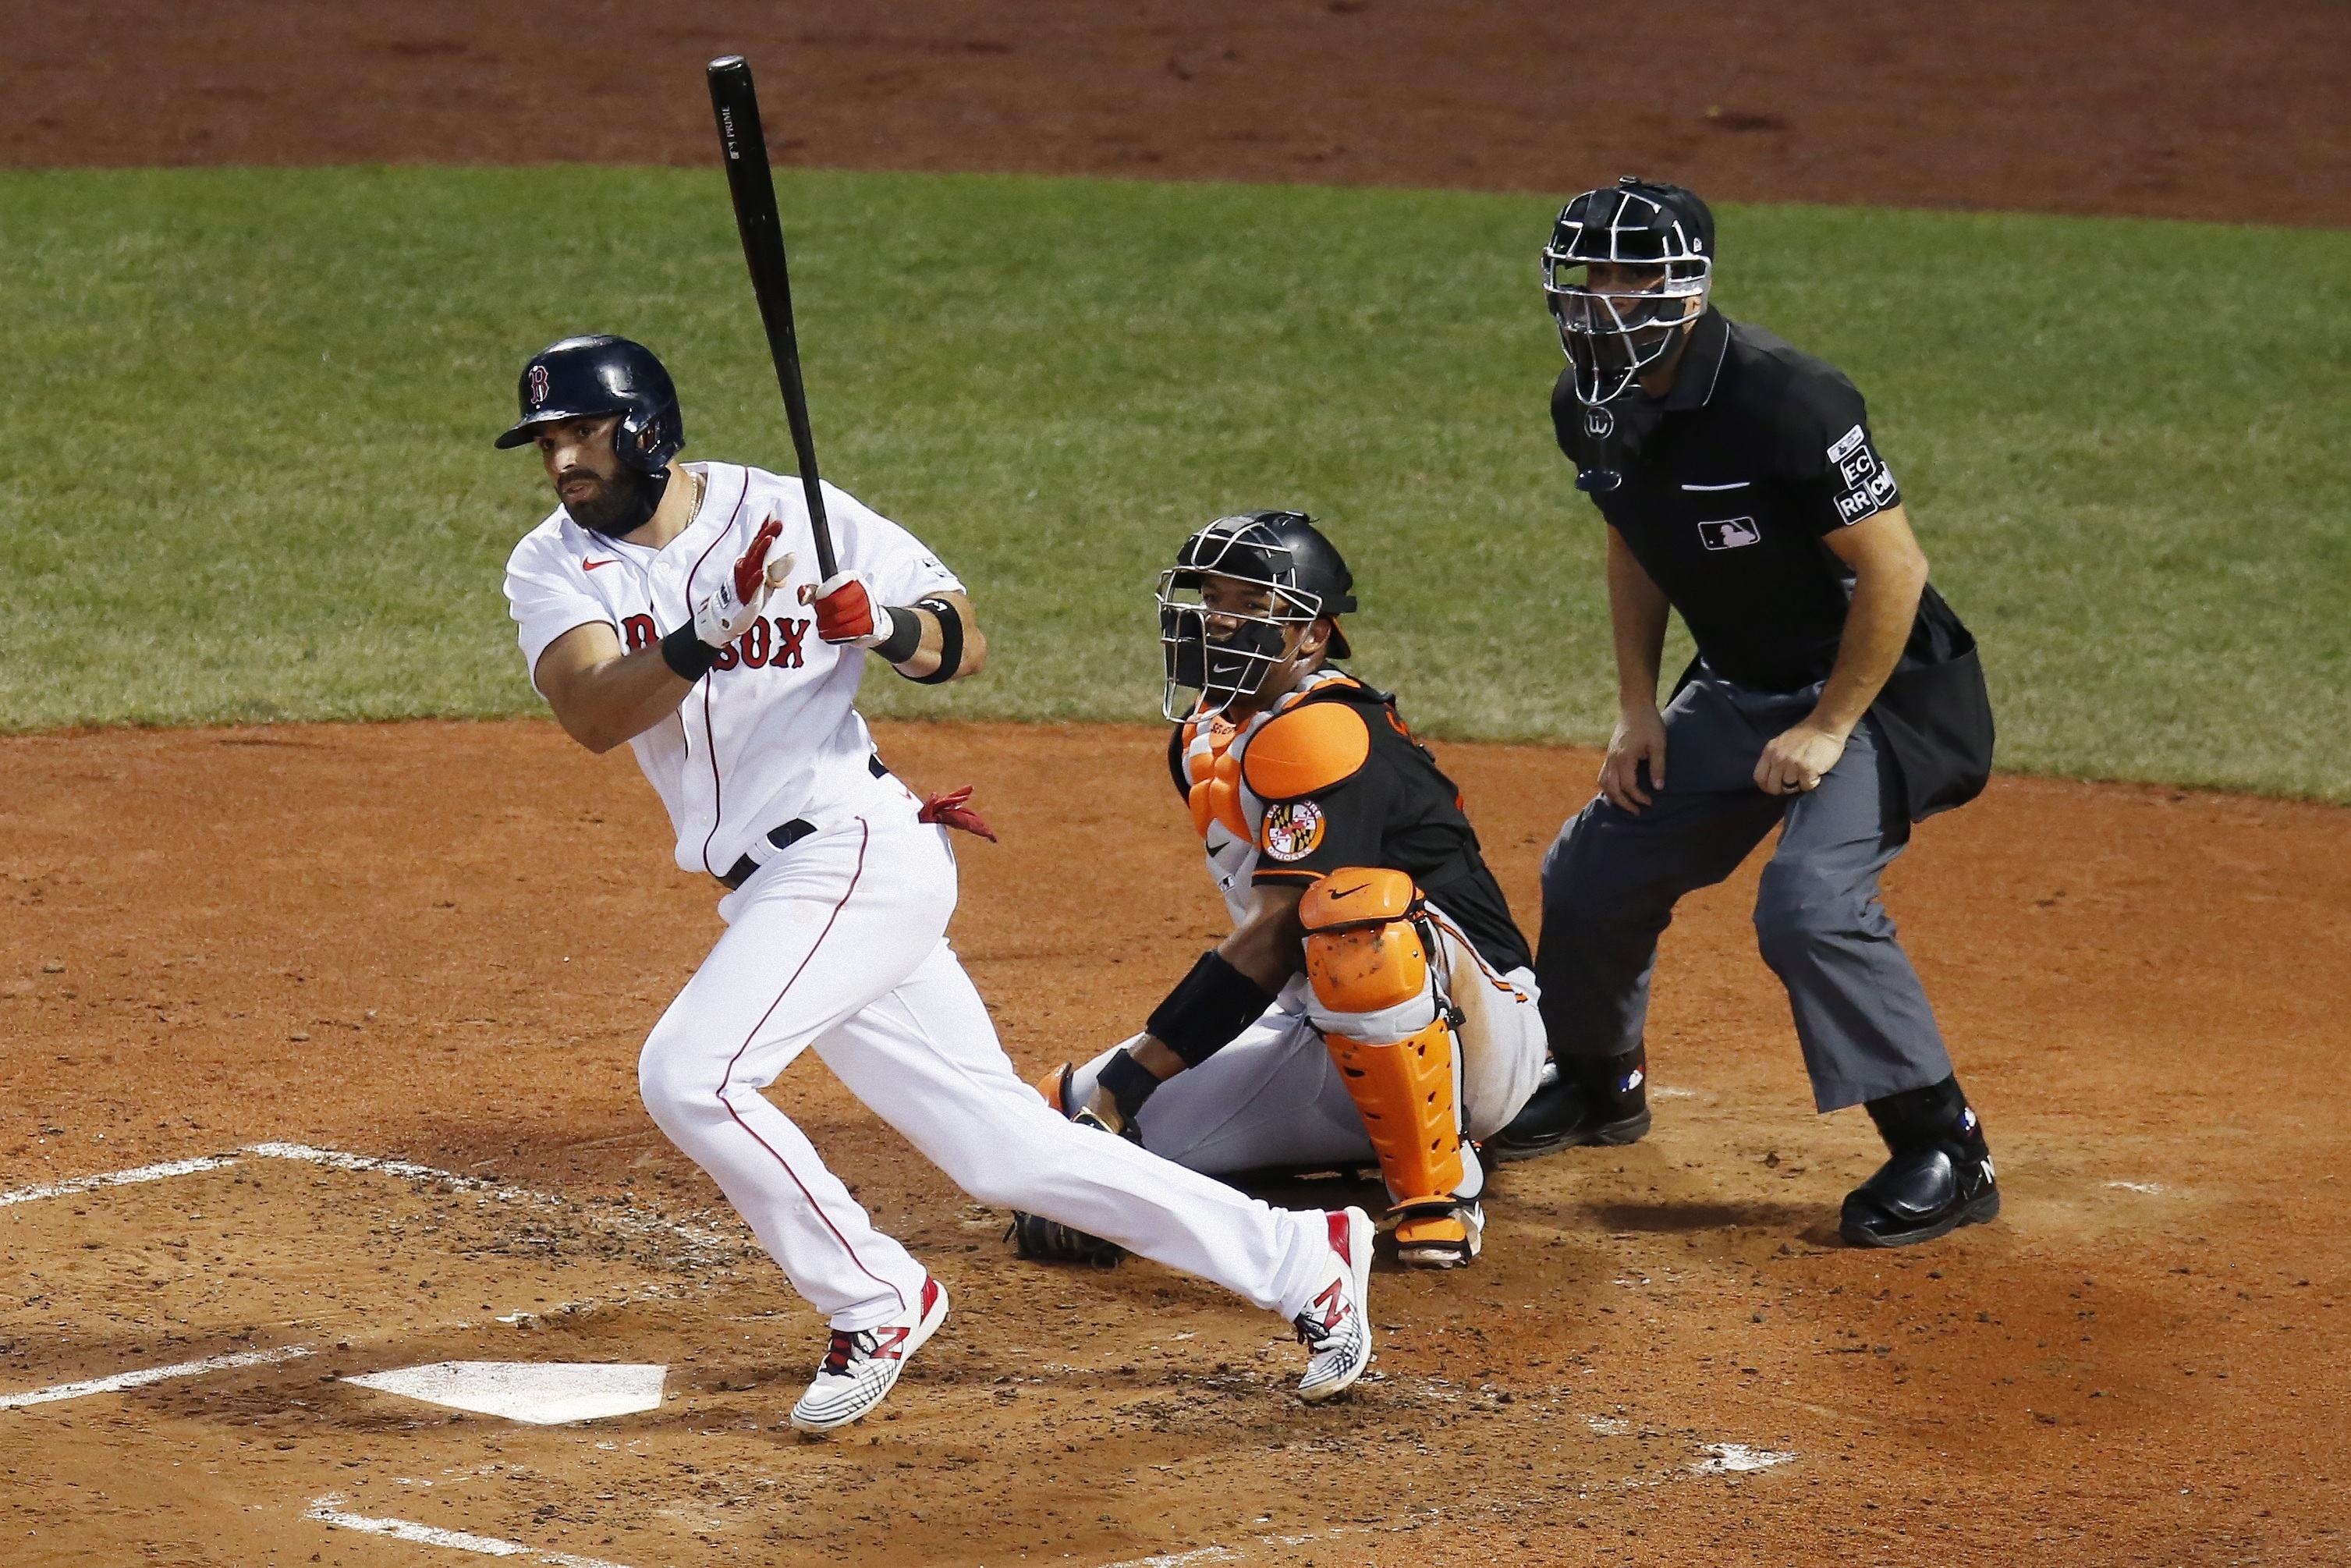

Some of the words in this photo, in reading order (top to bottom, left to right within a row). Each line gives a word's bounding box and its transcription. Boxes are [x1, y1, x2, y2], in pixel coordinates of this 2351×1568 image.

[529, 366, 549, 403] B
[1845, 455, 1870, 482] EC
[1840, 491, 1871, 516] RR
